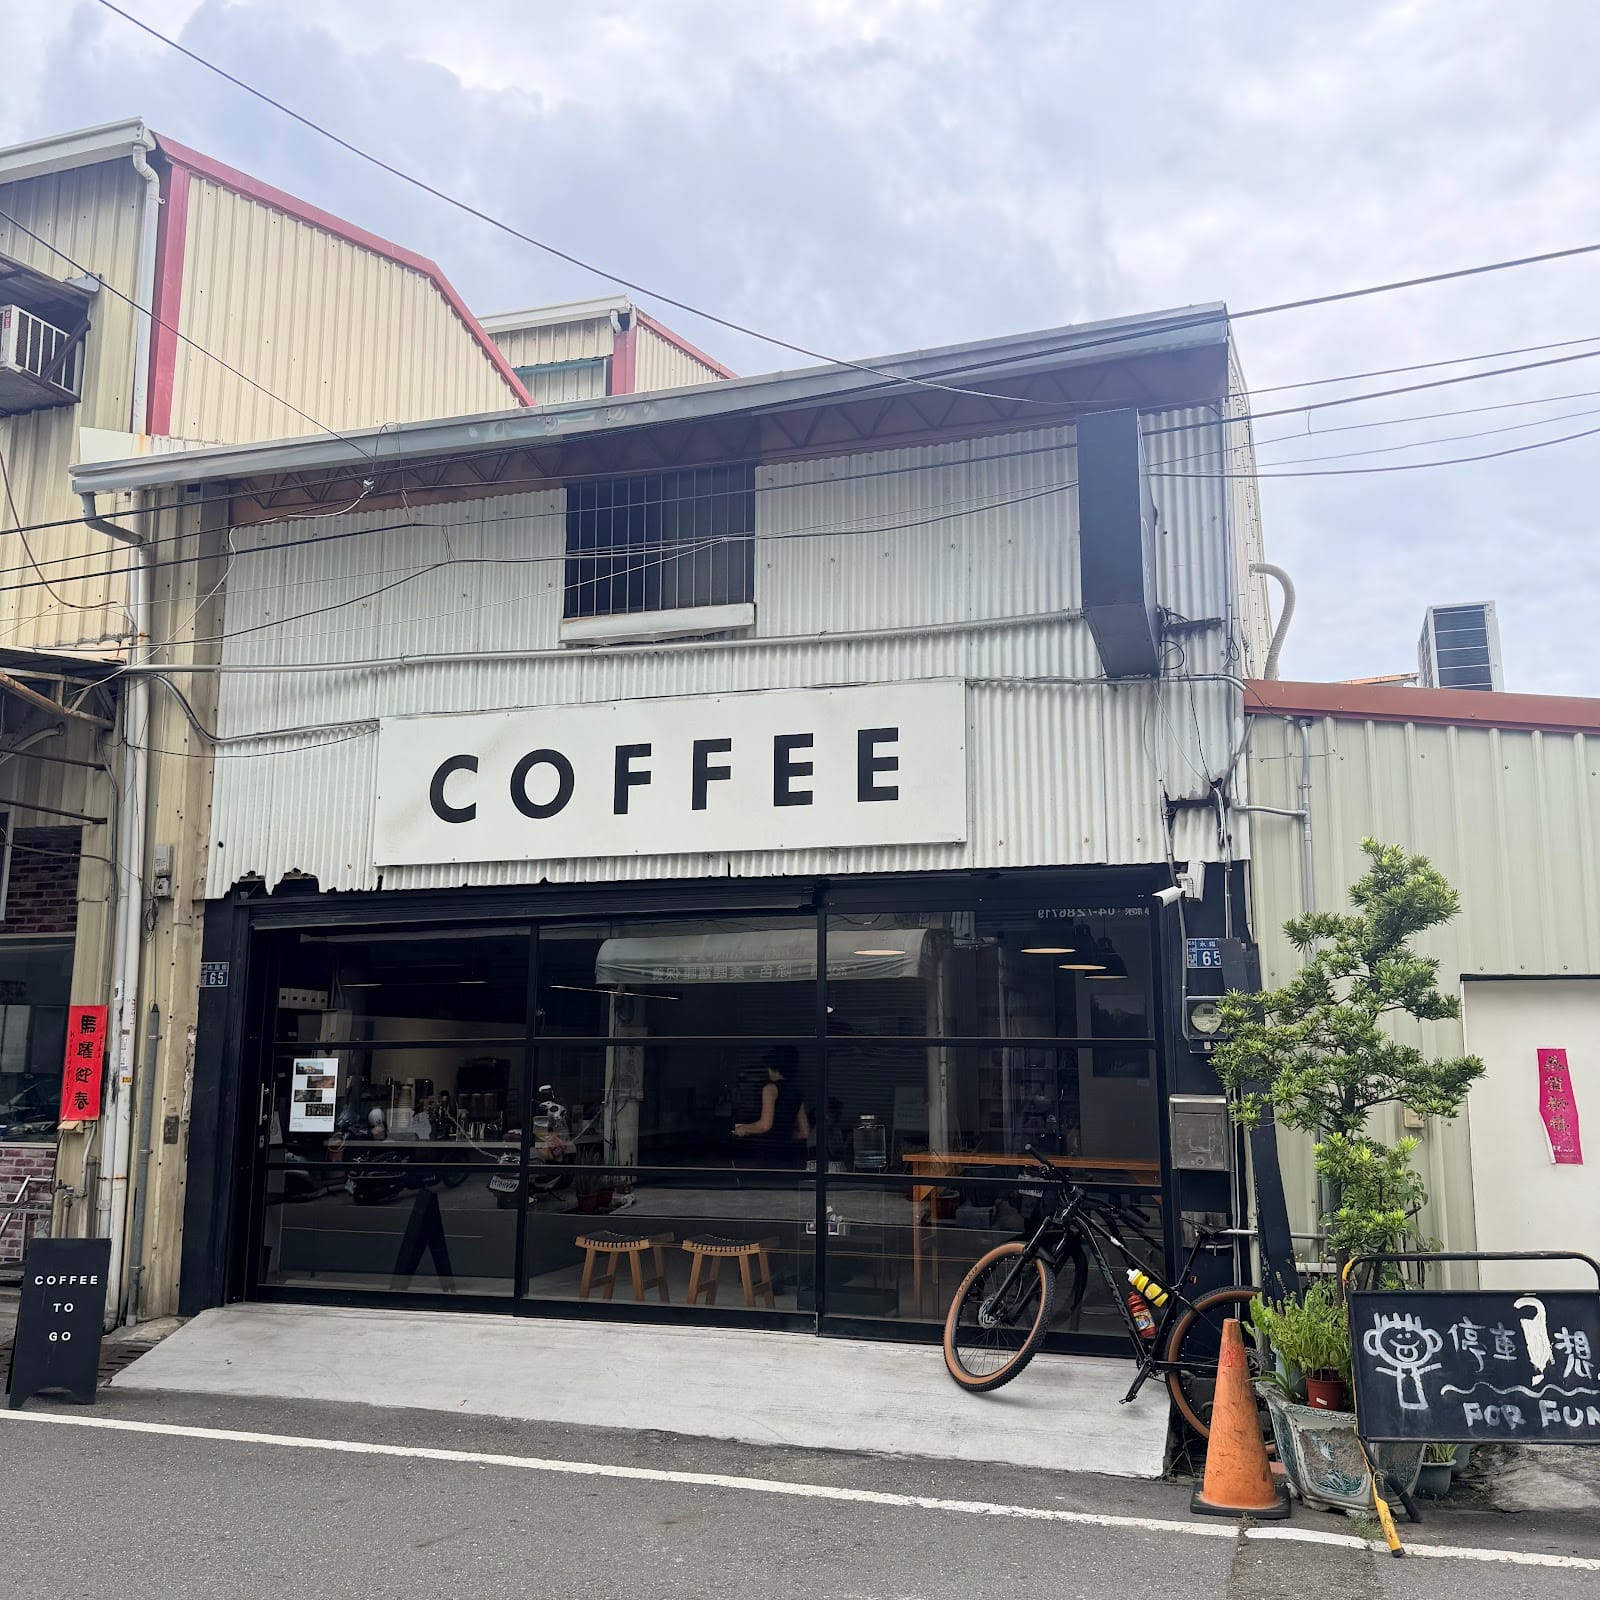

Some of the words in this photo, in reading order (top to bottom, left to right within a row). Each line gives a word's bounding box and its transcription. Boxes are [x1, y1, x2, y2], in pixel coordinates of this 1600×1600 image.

[429, 727, 899, 824] COFFEE
[1202, 950, 1222, 966] 65
[210, 972, 224, 985] 65
[34, 1275, 99, 1286] COFFEE
[53, 1303, 74, 1313] TO
[49, 1331, 71, 1342] GO
[1463, 1402, 1527, 1430] FOR
